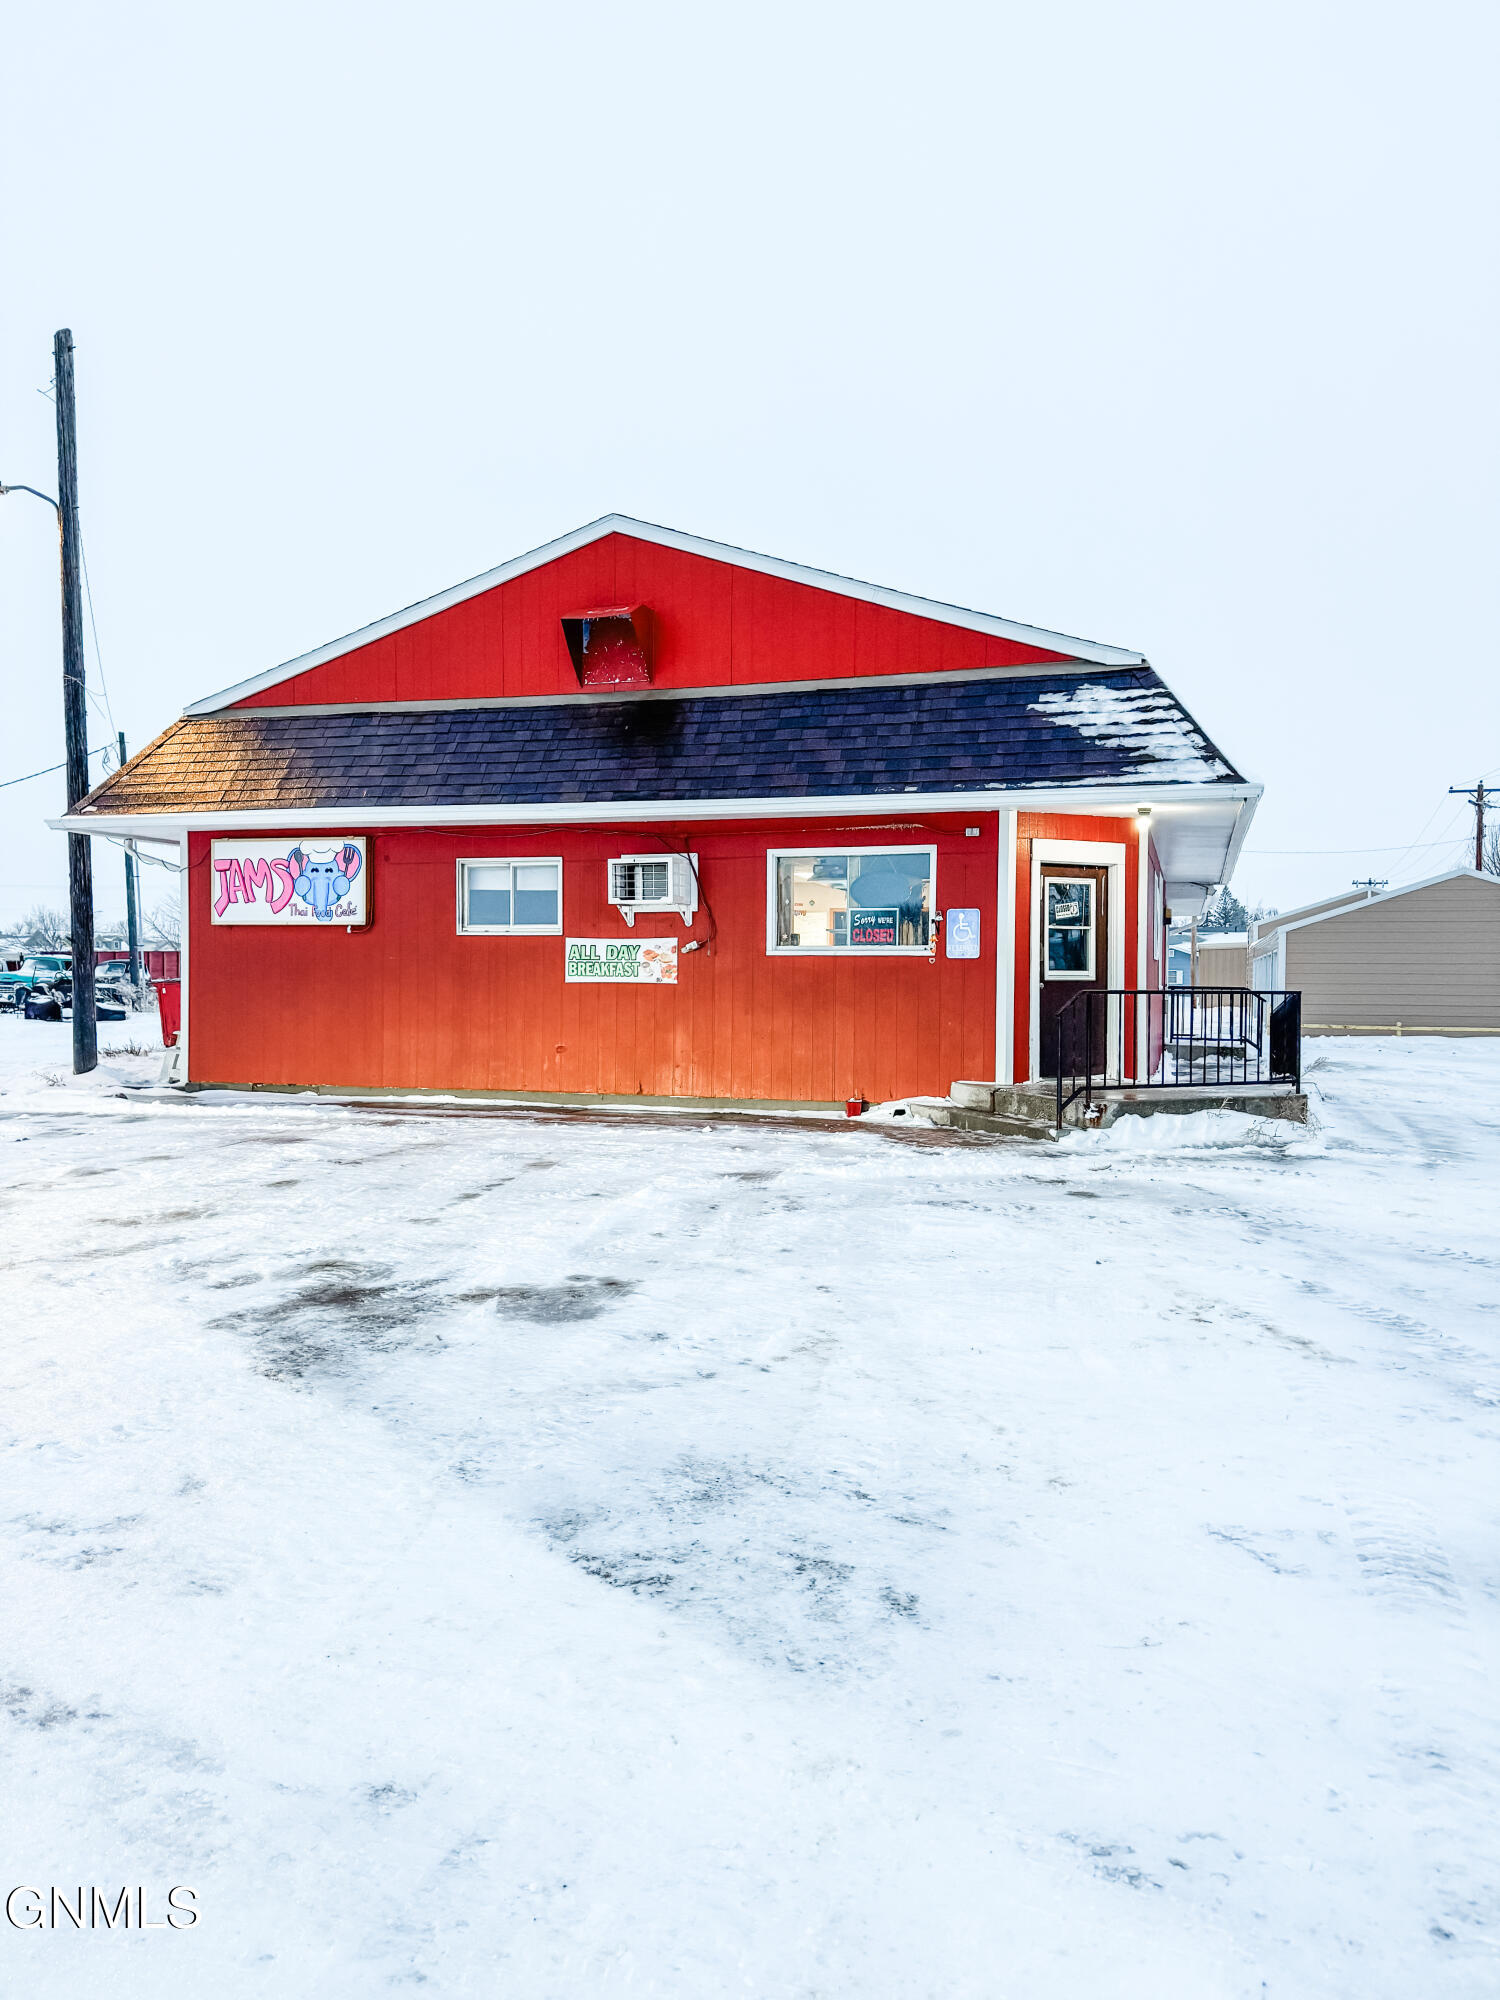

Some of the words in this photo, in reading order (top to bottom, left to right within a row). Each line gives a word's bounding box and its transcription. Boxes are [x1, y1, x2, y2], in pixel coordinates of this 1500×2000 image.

[213, 857, 295, 918] JAMS
[288, 903, 309, 917] Thai
[853, 914, 876, 927] Sorry
[852, 928, 895, 943] CLOSED
[568, 944, 601, 961] ALL
[605, 944, 641, 961] DAY
[567, 961, 641, 978] BREAKFAST
